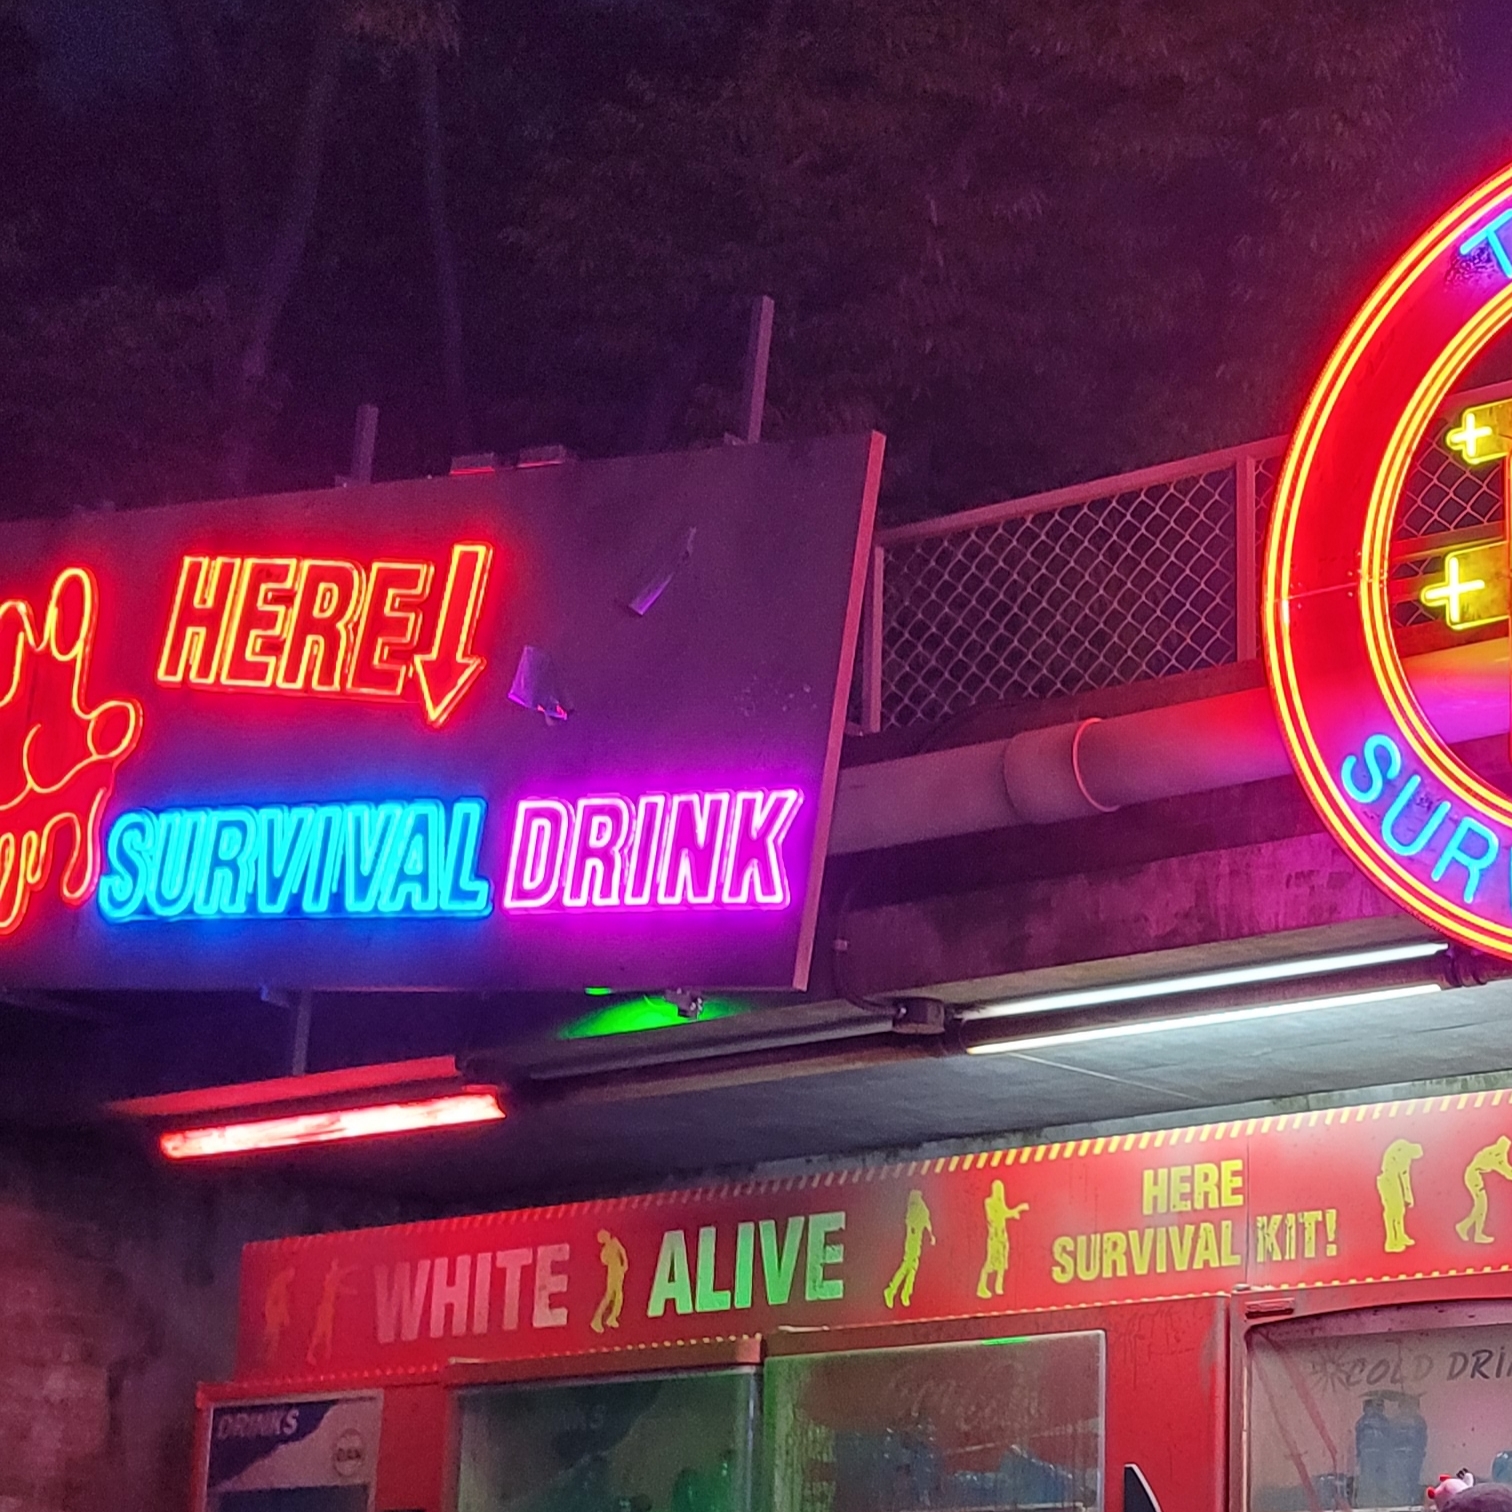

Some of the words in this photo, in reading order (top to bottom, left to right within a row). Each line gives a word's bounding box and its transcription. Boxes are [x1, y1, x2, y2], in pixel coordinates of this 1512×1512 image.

[97, 796, 493, 921] SURVIVAL
[503, 788, 804, 914] DRINK
[1142, 1159, 1244, 1216] HERE
[372, 1243, 571, 1344] WHITE
[647, 1211, 846, 1318] ALIVE
[1051, 1219, 1242, 1284] SURVIVAL
[1256, 1209, 1339, 1263] KIT!
